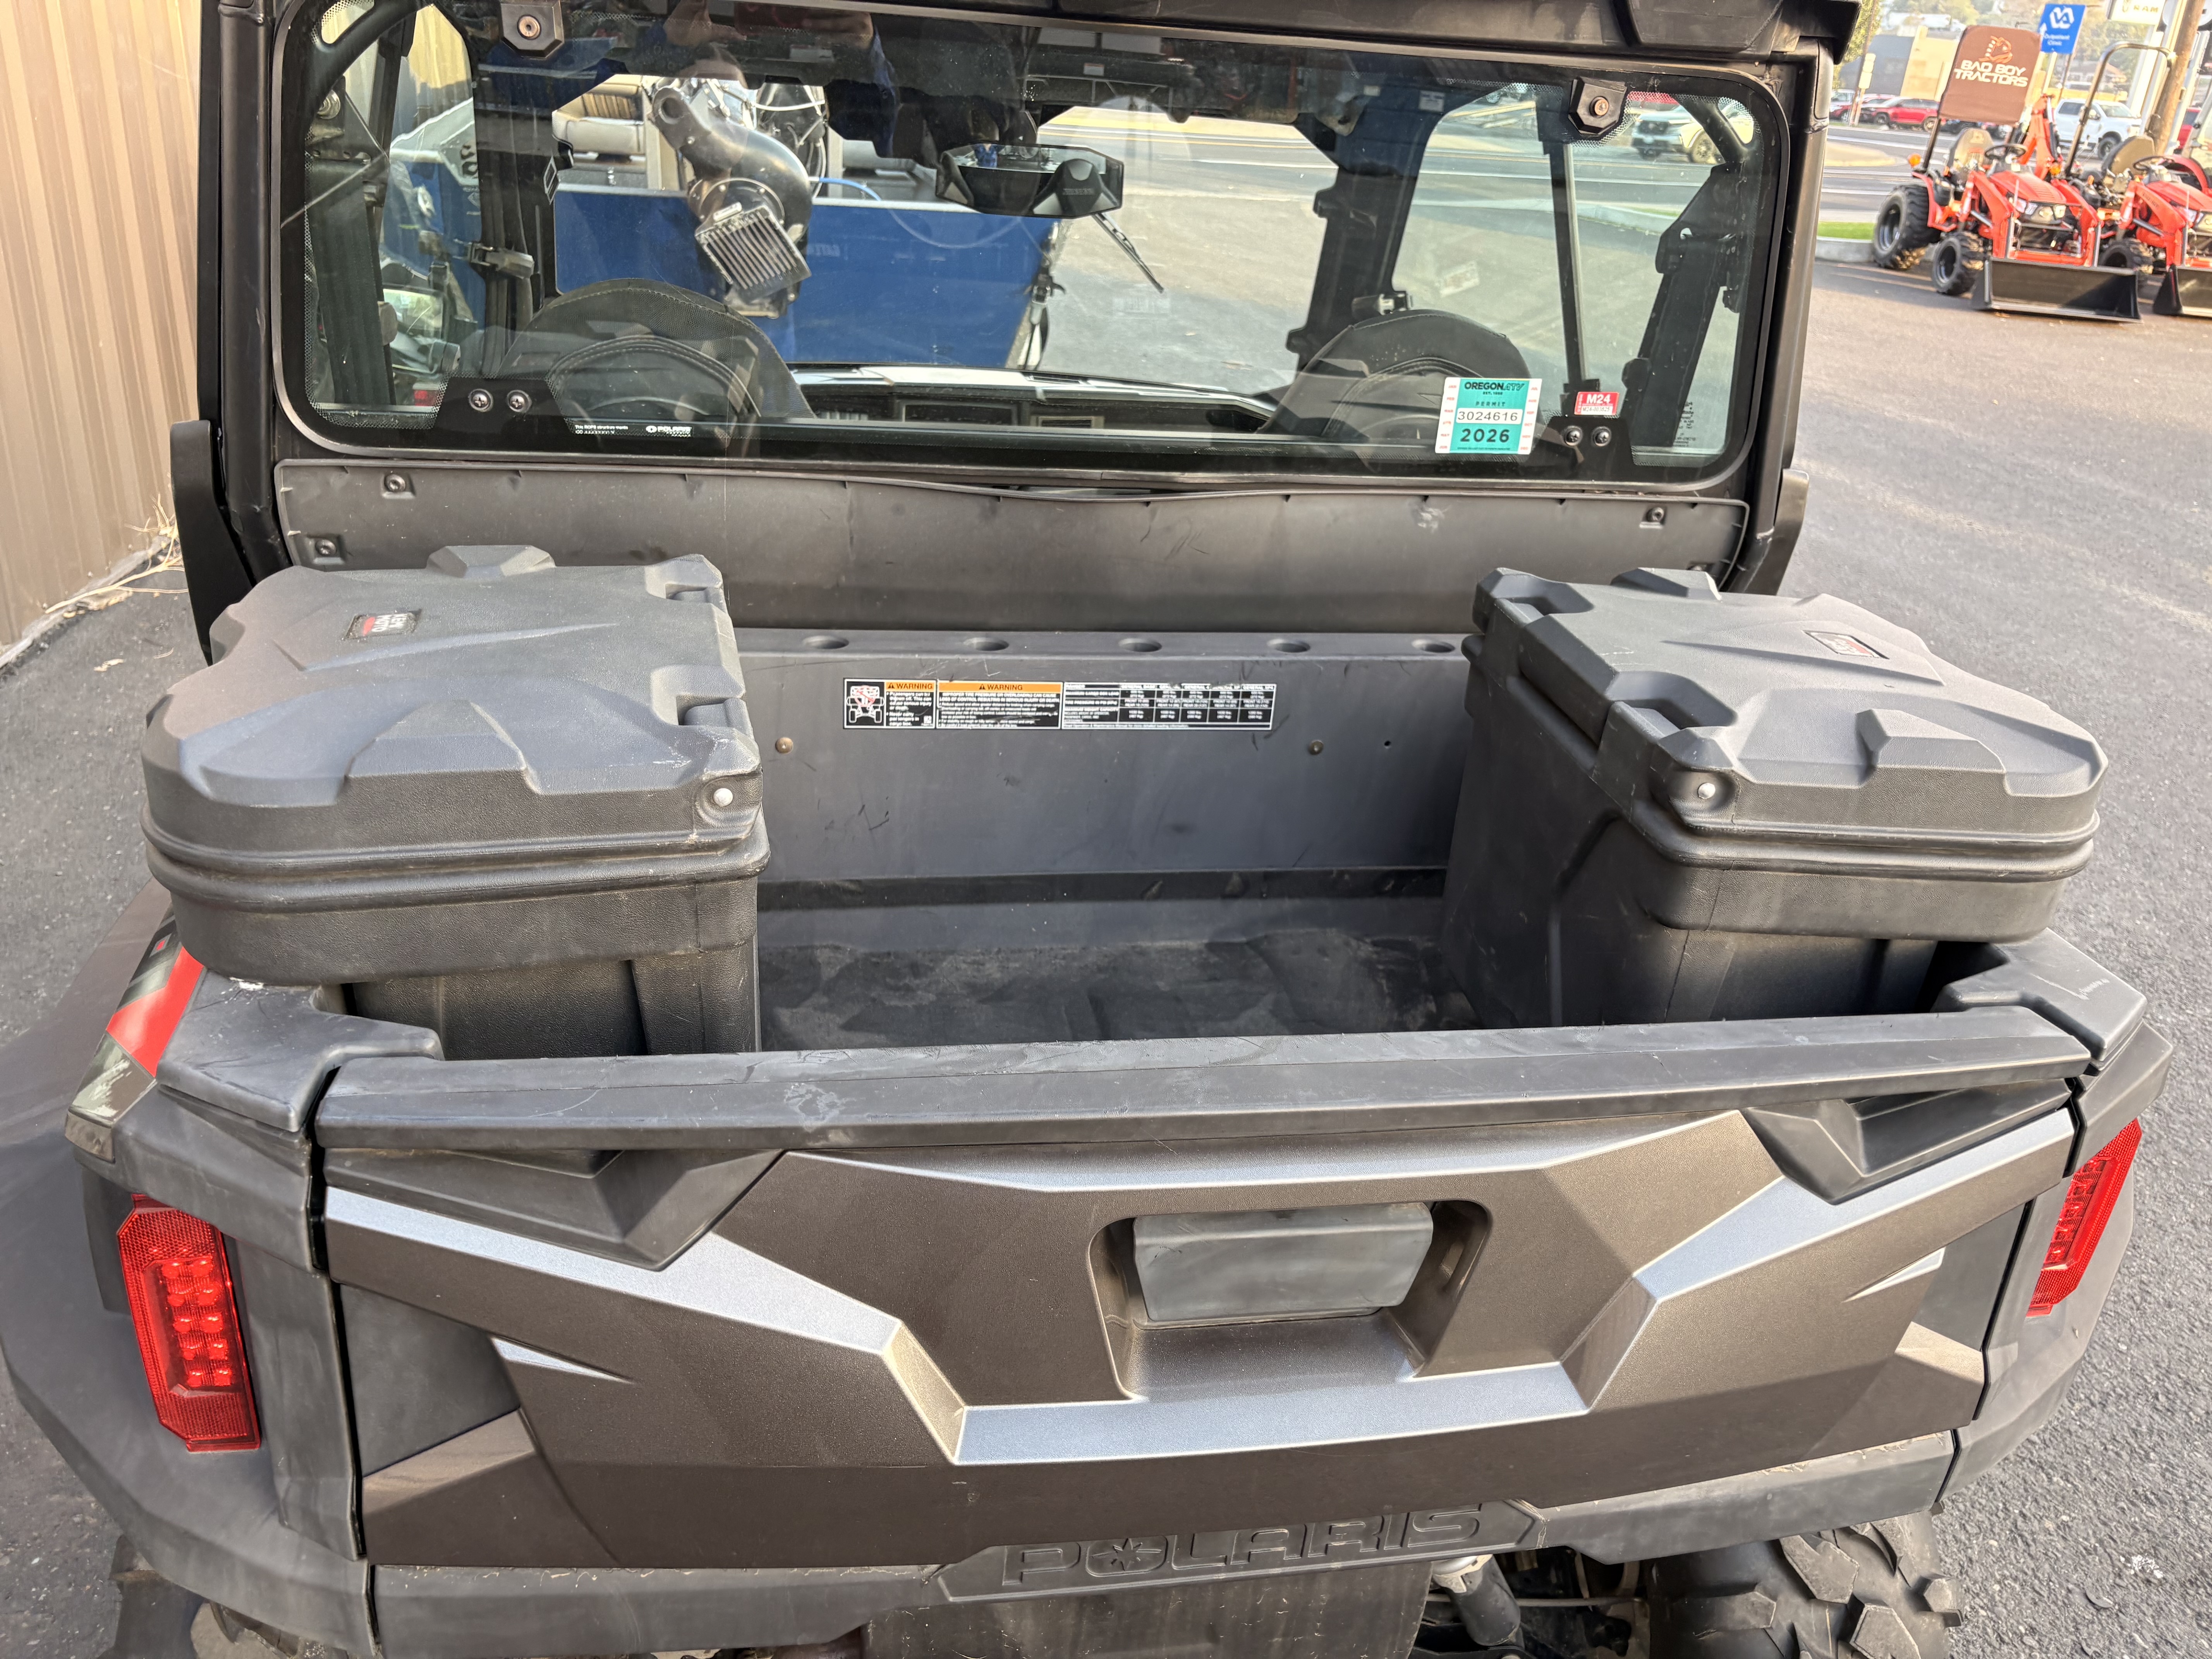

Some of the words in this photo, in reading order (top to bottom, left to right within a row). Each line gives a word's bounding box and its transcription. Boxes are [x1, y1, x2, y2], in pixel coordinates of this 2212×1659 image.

[2133, 5, 2159, 13] RAM
[1961, 60, 1993, 72] BAD
[1995, 64, 2026, 76] BOY
[1954, 68, 2028, 87] TRACTORS
[1465, 382, 1503, 390] OREGON
[1503, 383, 1525, 391] ATV
[1586, 394, 1611, 404] M24
[1458, 411, 1518, 421] 3024616
[1460, 428, 1510, 443] 2026
[1001, 1503, 1482, 1587] POLARIS
